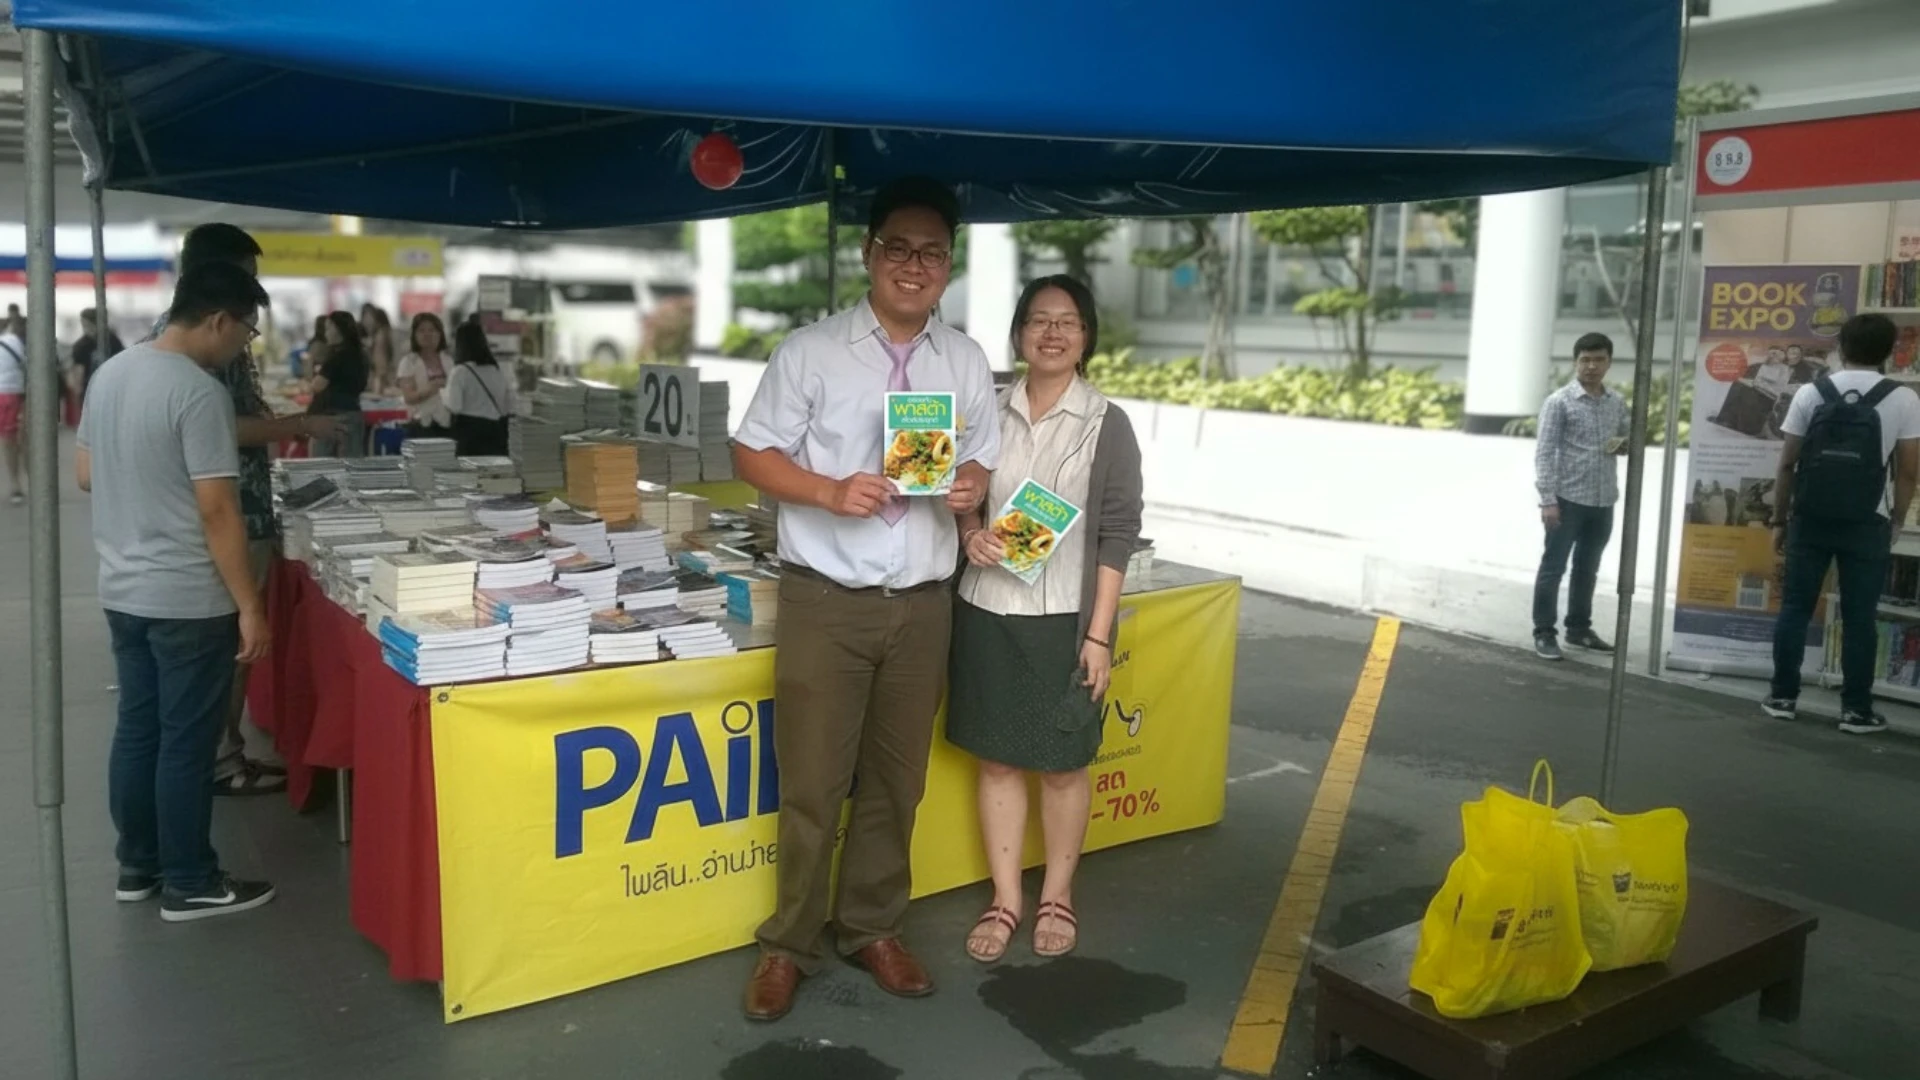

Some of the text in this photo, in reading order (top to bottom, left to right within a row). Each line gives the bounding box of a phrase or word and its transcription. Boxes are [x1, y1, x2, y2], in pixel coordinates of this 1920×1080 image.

[1711, 281, 1807, 306] BOOK
[1709, 307, 1796, 331] EXPO
[643, 372, 683, 437] 20
